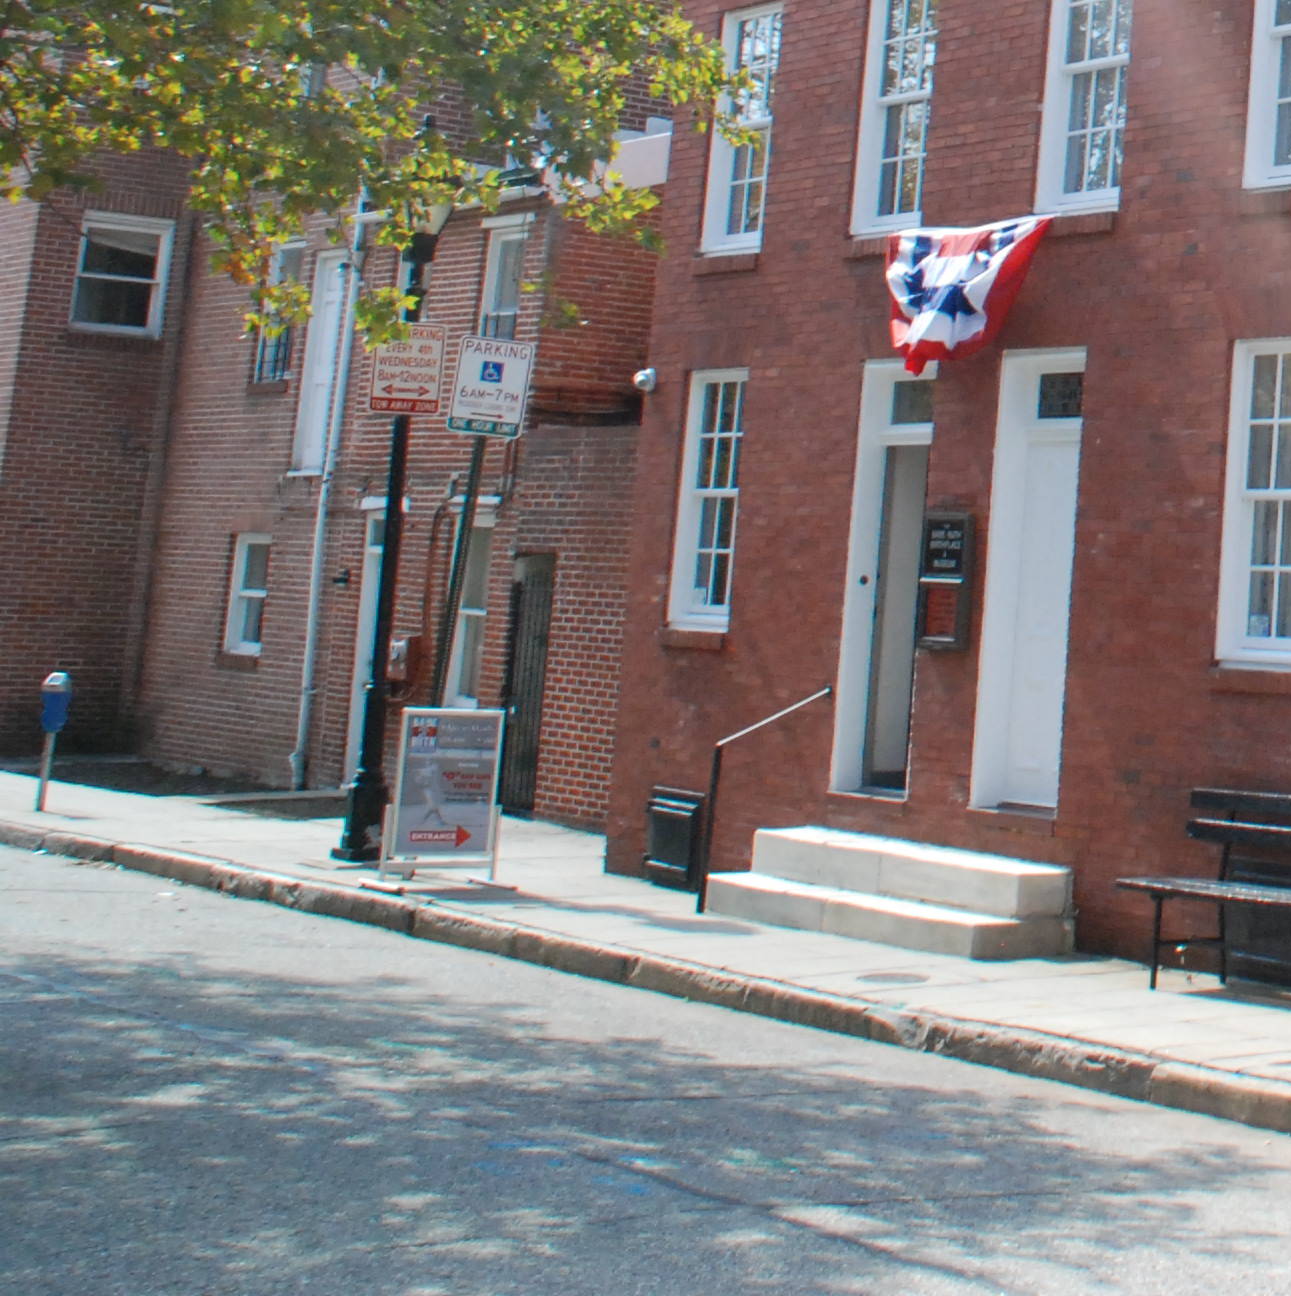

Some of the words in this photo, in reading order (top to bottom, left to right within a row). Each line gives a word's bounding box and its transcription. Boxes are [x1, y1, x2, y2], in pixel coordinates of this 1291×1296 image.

[386, 342, 412, 354] EVERY
[465, 340, 528, 360] PARKING
[379, 356, 438, 368] WEDNESDAY
[411, 832, 456, 841] ENTRANCE
